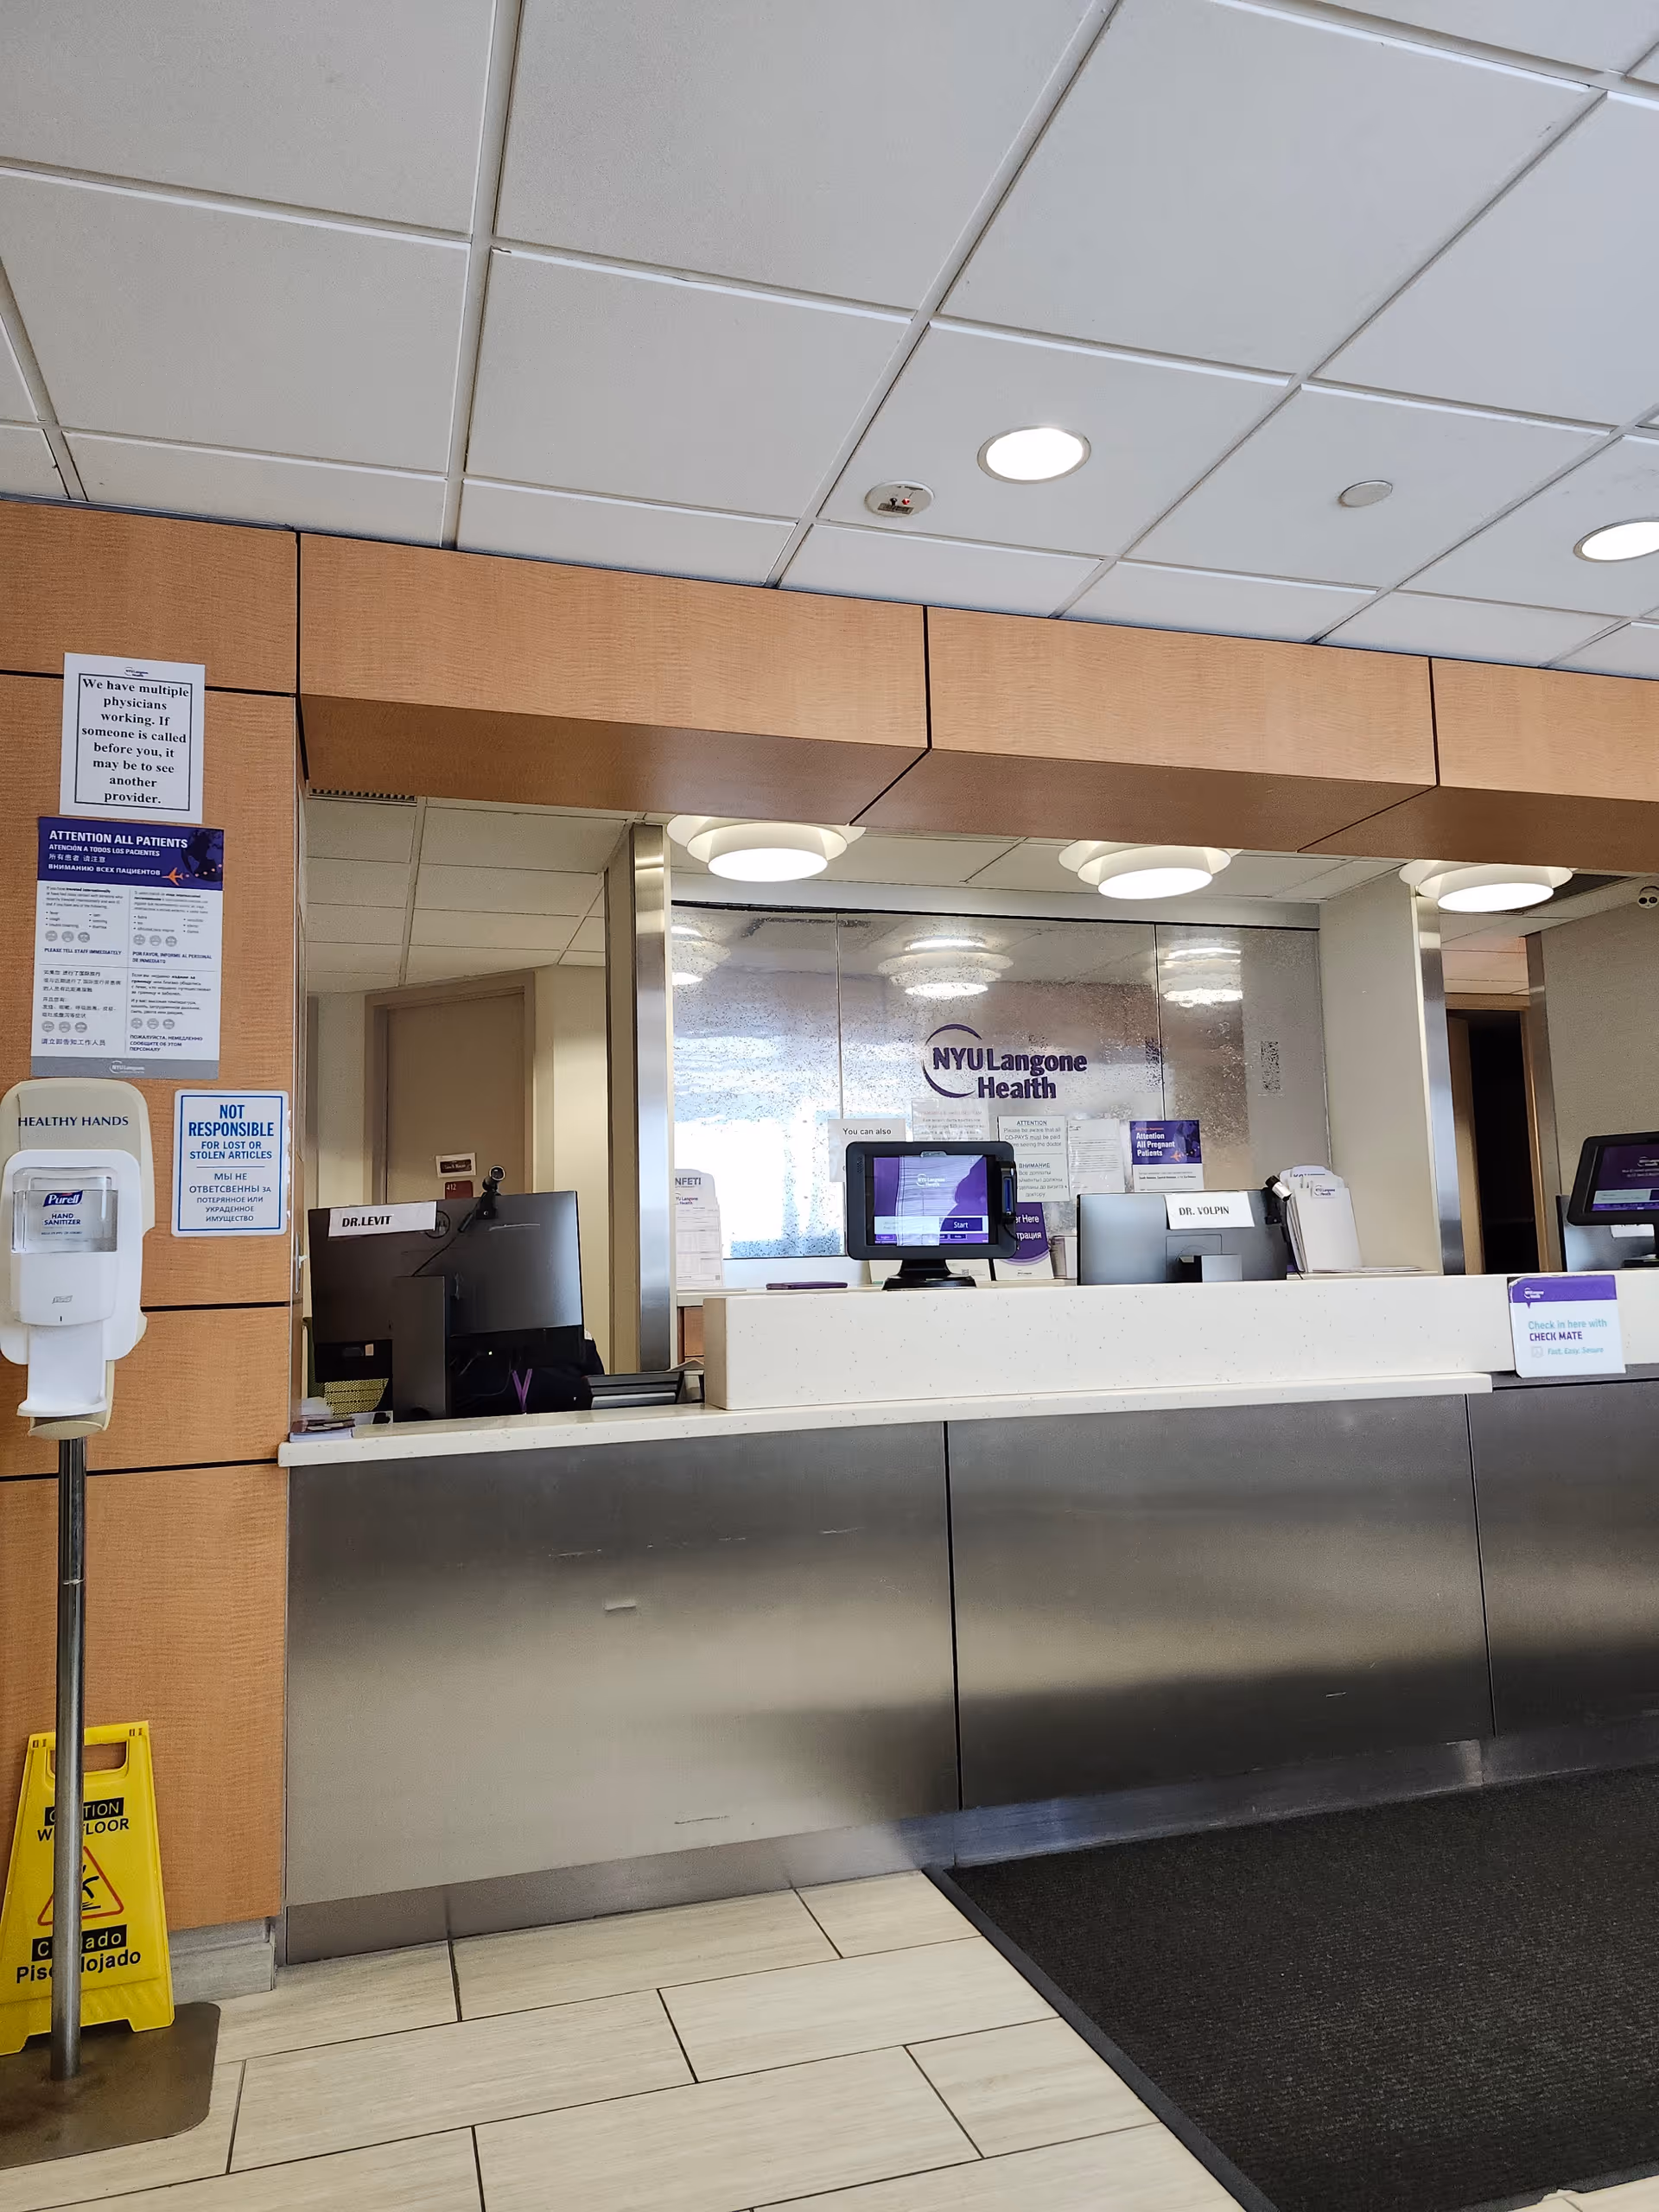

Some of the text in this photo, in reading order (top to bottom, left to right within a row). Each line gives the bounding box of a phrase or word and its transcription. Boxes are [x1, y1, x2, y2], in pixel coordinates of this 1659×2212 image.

[83, 678, 189, 698] We have multiple
[104, 696, 168, 710] physicians
[101, 713, 170, 727] working. If
[81, 728, 187, 743] someone is called
[93, 742, 175, 758] before you, it
[93, 760, 119, 771] may
[123, 760, 137, 771] be
[141, 762, 152, 771] to
[109, 777, 157, 788] another
[104, 792, 162, 804] provider.
[48, 830, 188, 849] ATTENTION ALL PATIENTS
[48, 843, 83, 852] ATENCIÓN
[125, 849, 161, 857] PACIENTES
[932, 1047, 1088, 1077] NYU Langone
[977, 1077, 1057, 1099] Health
[219, 1104, 245, 1119] NOT
[17, 1116, 129, 1127] HEALTHY HANDS
[188, 1122, 275, 1137] RESPONSIBLE
[201, 1141, 262, 1149] FOR LOST OR
[1147, 1141, 1175, 1149] Pregnant
[190, 1151, 272, 1160] STOLEN ARTICLES
[675, 1177, 702, 1185] NFETI
[48, 1194, 79, 1205] Purell
[1179, 1206, 1230, 1216] DR. VOLPIN
[342, 1215, 392, 1228] DR.LEVIT
[1021, 1215, 1039, 1224] Here
[1016, 1231, 1042, 1241] трация
[1528, 1319, 1607, 1330] Check in here with
[1529, 1331, 1583, 1341] CHECK MATE
[49, 1802, 119, 1822] CTION
[84, 1818, 130, 1835] LOOR
[37, 1931, 122, 1956] Cado
[81, 1949, 142, 1974] ojado
